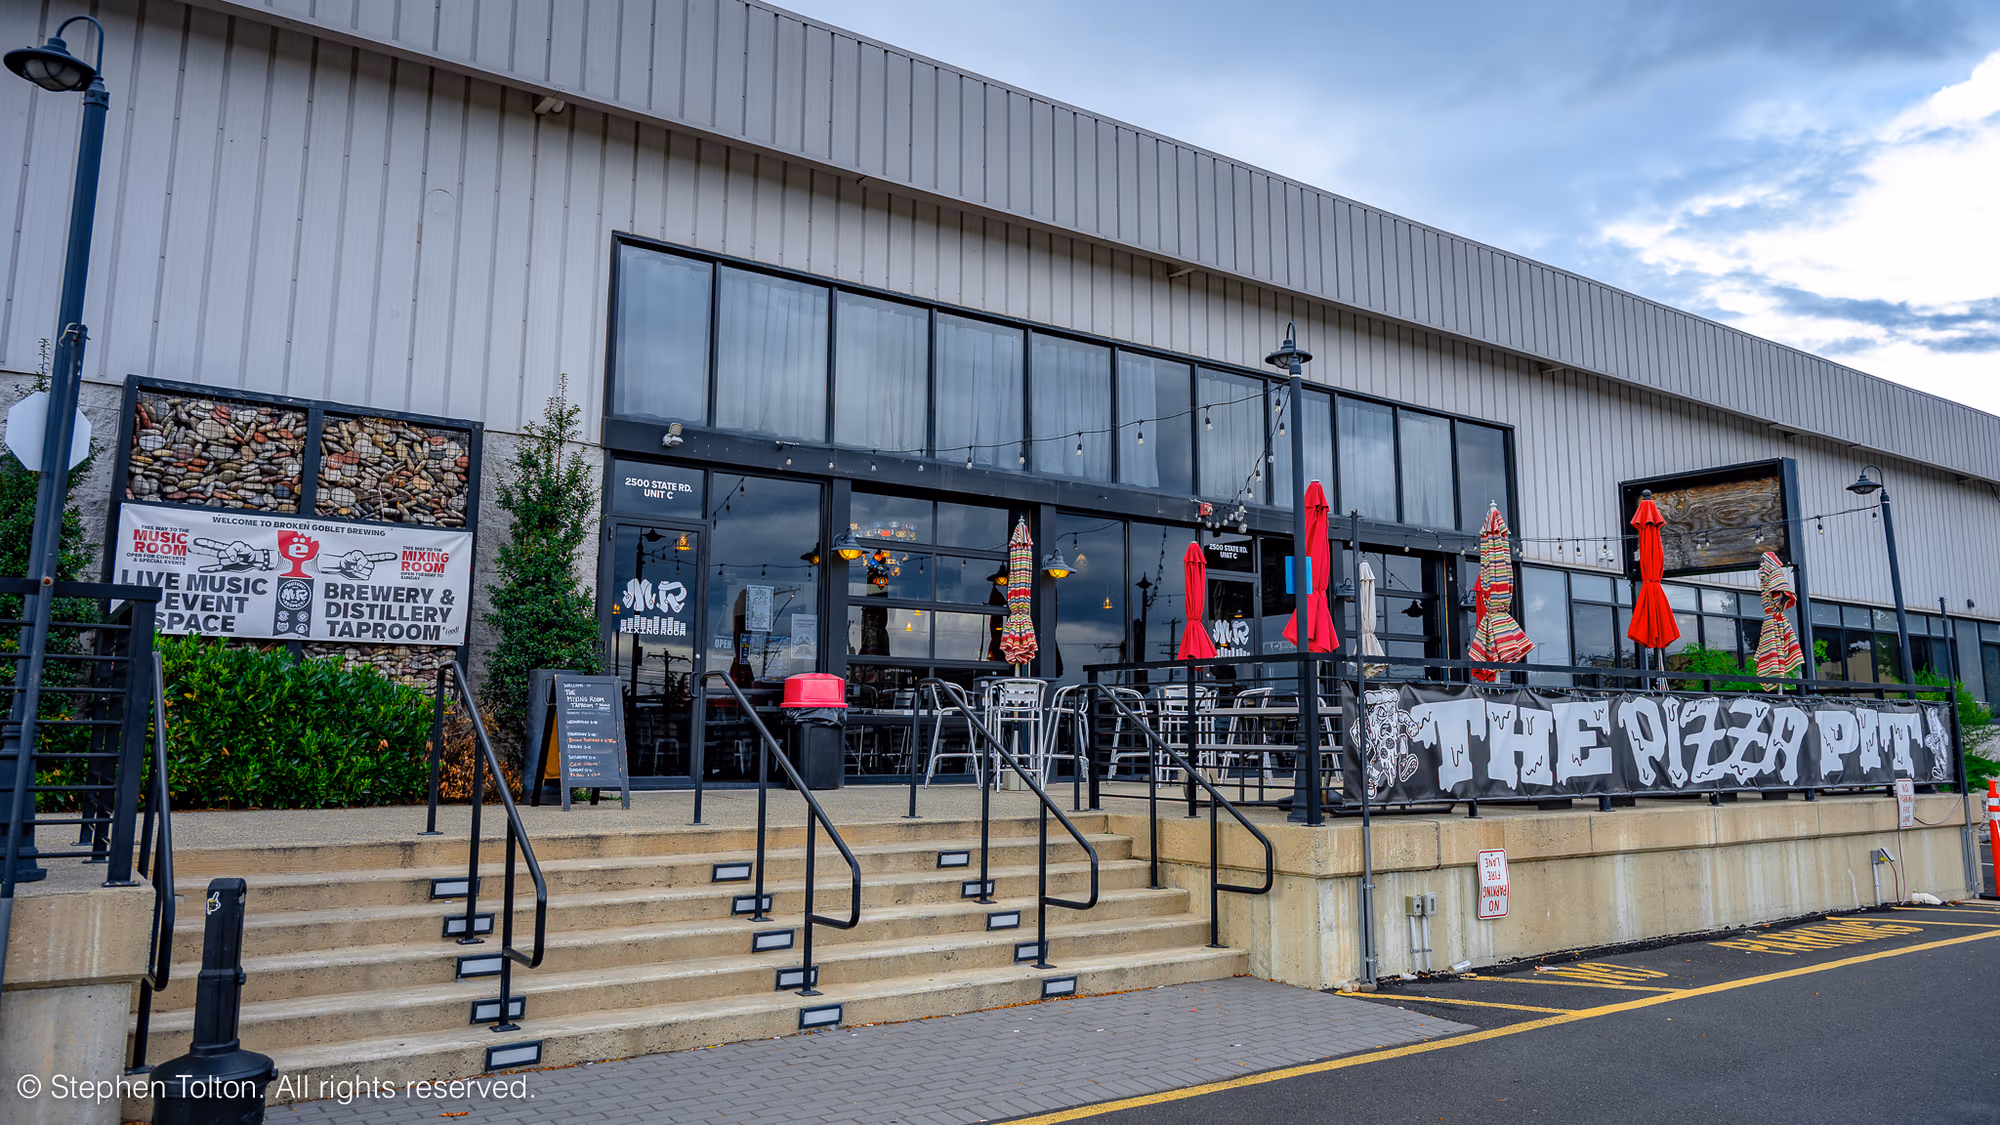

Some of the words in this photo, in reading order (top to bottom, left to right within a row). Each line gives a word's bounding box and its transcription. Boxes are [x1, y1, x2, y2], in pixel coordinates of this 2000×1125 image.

[624, 477, 650, 489] 2500
[651, 480, 677, 492] STATE
[678, 482, 693, 493] RD.
[643, 488, 665, 499] UNIT
[666, 491, 674, 500] C
[212, 516, 258, 527] WELCOME
[273, 521, 310, 531] BROKEN
[312, 524, 346, 534] GOBLET
[347, 527, 386, 537] BREWING
[133, 528, 189, 544] MUSIC
[133, 541, 187, 556] ROOM
[1208, 543, 1223, 551] 2500
[1224, 544, 1239, 553] STATE
[138, 557, 163, 565] SPECIAL
[401, 550, 450, 563] MIXING
[1220, 551, 1232, 559] UNIT
[401, 561, 445, 574] ROOM
[121, 569, 180, 590] LIVE
[186, 573, 269, 596] MUSIC
[324, 582, 435, 604] BREWERY
[440, 589, 455, 605] &
[165, 592, 250, 614] EVENT
[325, 601, 453, 623] DISTILLERY
[154, 611, 236, 633] SPACE
[326, 620, 441, 641] TAPROOM
[620, 626, 659, 635] MIXING
[660, 628, 687, 637] ROOM
[714, 639, 732, 649] OPEN
[566, 695, 588, 703] MIXING
[589, 695, 605, 703] ROOM
[1410, 697, 1614, 792] THE
[1618, 696, 1808, 787] PIZZA
[1814, 707, 1924, 780] PIT
[1901, 784, 1908, 792] NO
[1485, 857, 1500, 867] LANE
[1487, 871, 1500, 880] FIRE
[1483, 884, 1507, 898] PARKING
[1489, 900, 1499, 911] NO
